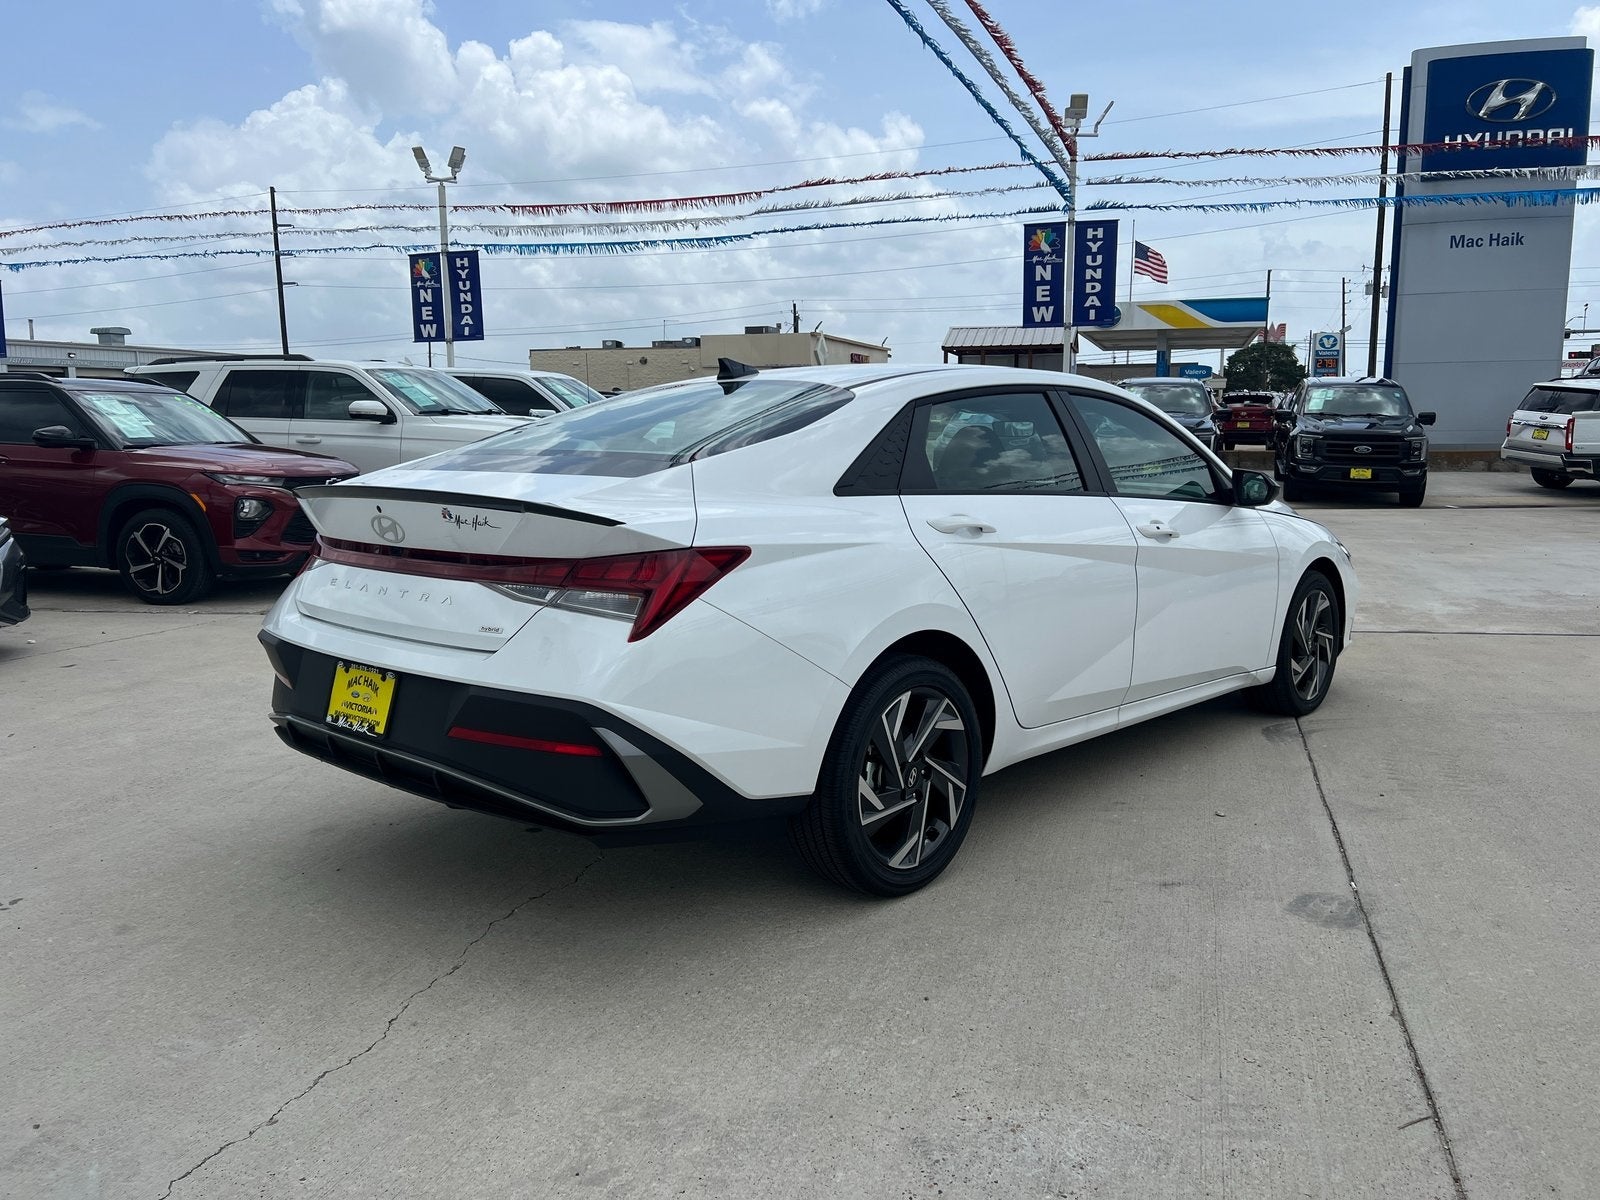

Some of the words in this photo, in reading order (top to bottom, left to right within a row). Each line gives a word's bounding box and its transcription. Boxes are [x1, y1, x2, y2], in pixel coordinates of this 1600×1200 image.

[1444, 128, 1573, 150] HYUNDAI
[1450, 235, 1484, 249] Mac
[1489, 232, 1525, 247] Haik
[1084, 227, 1104, 320] HYUNDAI
[455, 257, 474, 336] HYUNDAI
[1032, 265, 1054, 322] NEW
[419, 289, 437, 338] NEW
[1184, 368, 1207, 376] Valero
[454, 514, 471, 529] Mac
[471, 514, 502, 531] Haik
[329, 578, 454, 606] ELANTRA
[480, 626, 501, 634] hybrid
[346, 675, 363, 690] MAC
[363, 675, 380, 697] HAIK
[346, 701, 374, 715] VICTORIA
